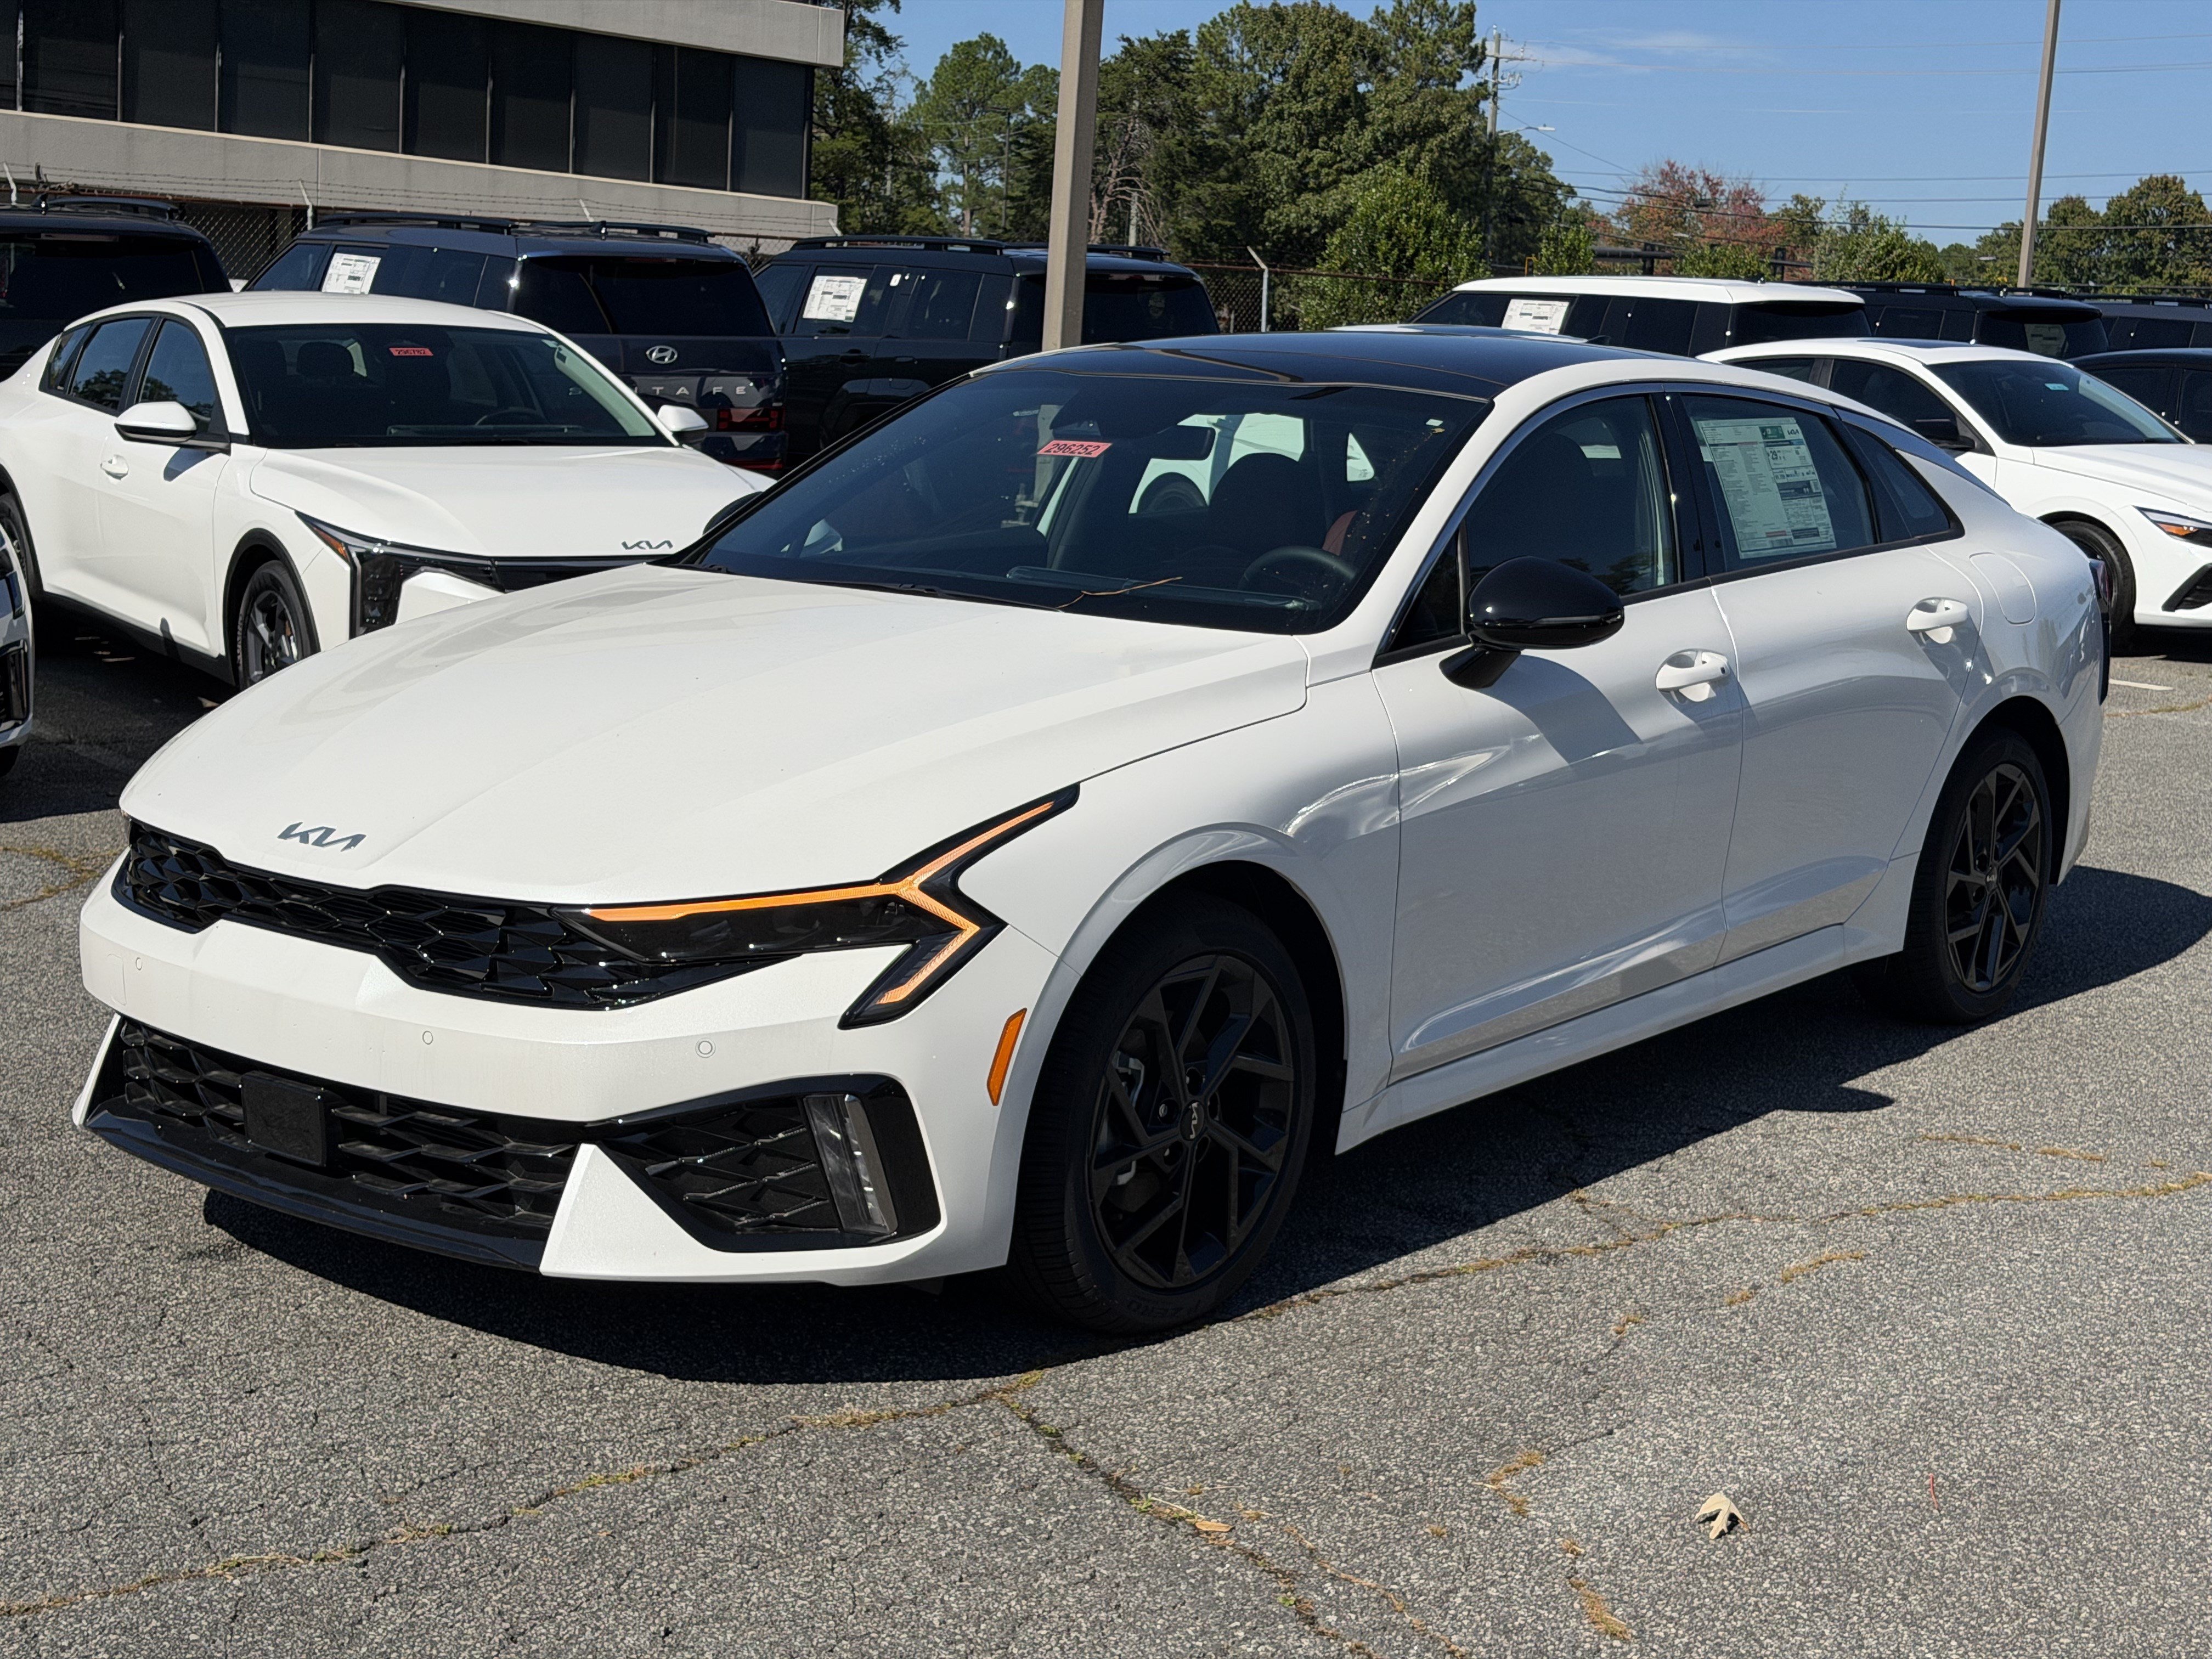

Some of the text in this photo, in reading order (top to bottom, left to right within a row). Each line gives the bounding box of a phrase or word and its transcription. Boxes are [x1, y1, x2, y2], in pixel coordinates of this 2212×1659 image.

[713, 386, 747, 395] FE
[1043, 443, 1101, 455] 296252
[621, 540, 674, 550] KIA
[277, 821, 366, 852] KIA
[1189, 1102, 1198, 1139] KIA
